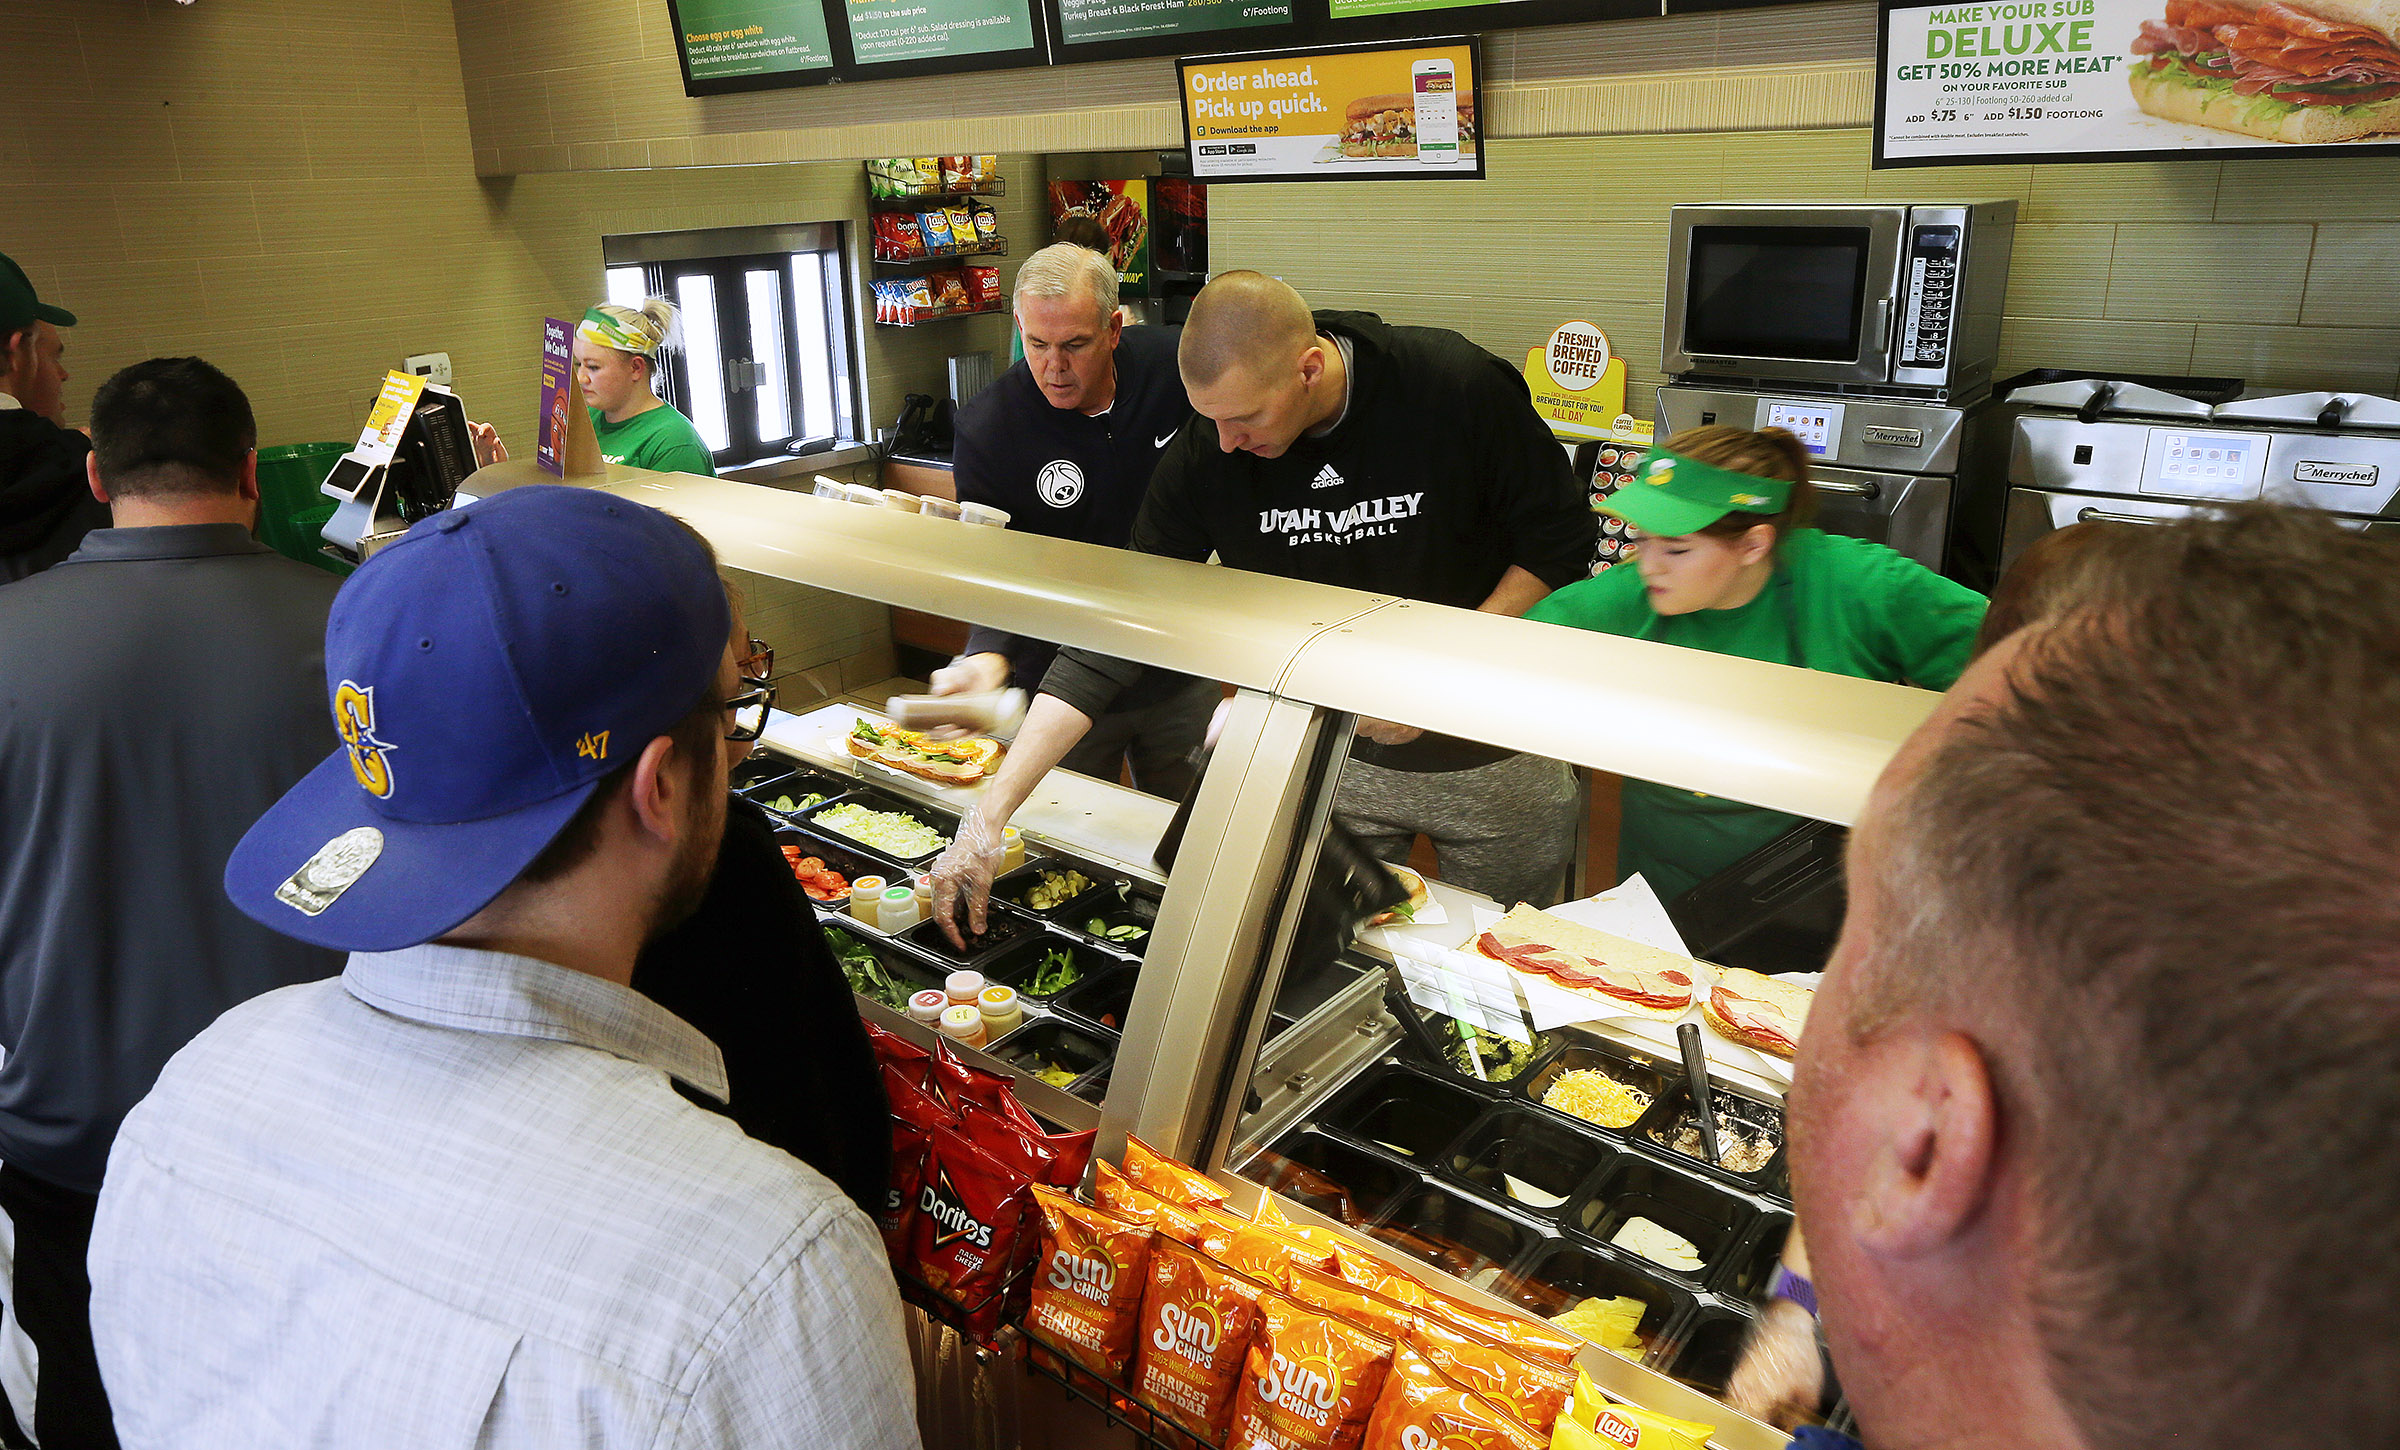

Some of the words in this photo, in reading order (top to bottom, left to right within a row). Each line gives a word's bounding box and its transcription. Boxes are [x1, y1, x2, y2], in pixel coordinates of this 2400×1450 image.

[852, 13, 864, 22] Add
[890, 9, 900, 17] the
[901, 7, 911, 16] sub
[912, 5, 927, 16] price
[1063, 11, 1087, 20] Turkey
[1088, 8, 1111, 17] Breast
[1112, 6, 1118, 14] &
[1119, 3, 1140, 13] Black
[1141, 1, 1165, 11] Forest
[1166, 0, 1184, 8] Ham
[1928, 7, 1984, 25] MAKE
[1988, 3, 2047, 21] YOUR
[2052, 0, 2095, 17] SUB
[686, 33, 709, 43] Choose
[710, 32, 722, 42] egg
[731, 29, 744, 39] egg
[744, 24, 764, 36] white
[880, 29, 890, 37] 170
[890, 27, 899, 36] cal
[900, 27, 910, 36] per
[918, 24, 930, 33] sub.
[930, 22, 948, 32] Salad
[949, 19, 975, 29] dressing
[975, 17, 981, 27] is
[982, 15, 1011, 25] available
[860, 42, 875, 50] upon
[875, 39, 897, 48] request
[917, 34, 936, 43] added
[1926, 20, 2095, 59] DELUXE
[1192, 71, 1247, 93] Order
[1252, 65, 1319, 89] ahead.
[1897, 64, 1936, 81] GET
[1939, 62, 1982, 79] 50%
[1987, 59, 2050, 77] MORE
[1942, 84, 1958, 92] ON
[1960, 82, 1990, 92] YOUR
[1992, 81, 2043, 91] FAVORITE
[2045, 80, 2068, 89] SUB
[1195, 97, 1235, 118] Pick
[1240, 100, 1264, 120] up
[1269, 92, 1328, 119] quick.
[1945, 96, 1971, 106] 25-130
[1976, 95, 2008, 106] Footlong
[2009, 94, 2036, 104] 50-260
[2037, 94, 2061, 103] added
[2062, 93, 2073, 102] cal
[1905, 114, 1925, 123] ADD
[1931, 109, 1956, 122] $.75
[1983, 112, 2004, 121] ADD
[2008, 107, 2043, 120] $1.50
[2046, 109, 2104, 119] FOOTLONG
[1210, 125, 1248, 135] Download
[1250, 125, 1262, 133] the
[1264, 125, 1279, 134] app
[1117, 272, 1143, 283] BWAY
[1934, 321, 1940, 329] 7
[1935, 311, 1941, 319] 6
[1557, 331, 1602, 348] FRESHLY
[1552, 344, 1602, 363] BREWED
[1930, 352, 1936, 360] 0
[1553, 359, 1598, 378] COFFEE
[1536, 395, 1560, 405] BREWED
[1561, 398, 1576, 409] JUST
[1576, 401, 1588, 411] FOR
[1590, 404, 1604, 413] YOU!
[1552, 408, 1566, 419] ALL
[1568, 410, 1584, 422] DAY
[1311, 476, 1345, 489] adidas
[1259, 508, 1321, 534] UTAH
[1325, 492, 1425, 533] VALLEY
[1289, 523, 1398, 546] BASKETBALL
[920, 1184, 992, 1247] Doritos
[954, 1254, 983, 1272] CHEESE
[958, 1248, 984, 1264] NACHO
[1048, 1249, 1116, 1292] Sun
[1072, 1279, 1110, 1307] CHIPS
[1067, 1297, 1085, 1314] WHOLE
[1085, 1306, 1103, 1323] GRAIN
[1043, 1302, 1105, 1341] HARVEST
[1153, 1302, 1221, 1353] Sun
[1038, 1315, 1101, 1353] CHEDDAR
[1175, 1339, 1213, 1369] CHIPS
[1153, 1352, 1168, 1366] 100%
[1169, 1357, 1188, 1377] WHOLE
[1187, 1368, 1206, 1386] GRAIN
[1145, 1364, 1209, 1406] HARVEST
[1258, 1352, 1341, 1410] Sun
[1143, 1378, 1207, 1418] CHEDDAR
[1278, 1392, 1329, 1427] CHIPS
[1272, 1411, 1294, 1433] WHOLE
[1294, 1422, 1318, 1444] GRAIN
[1595, 1412, 1638, 1443] Lay's
